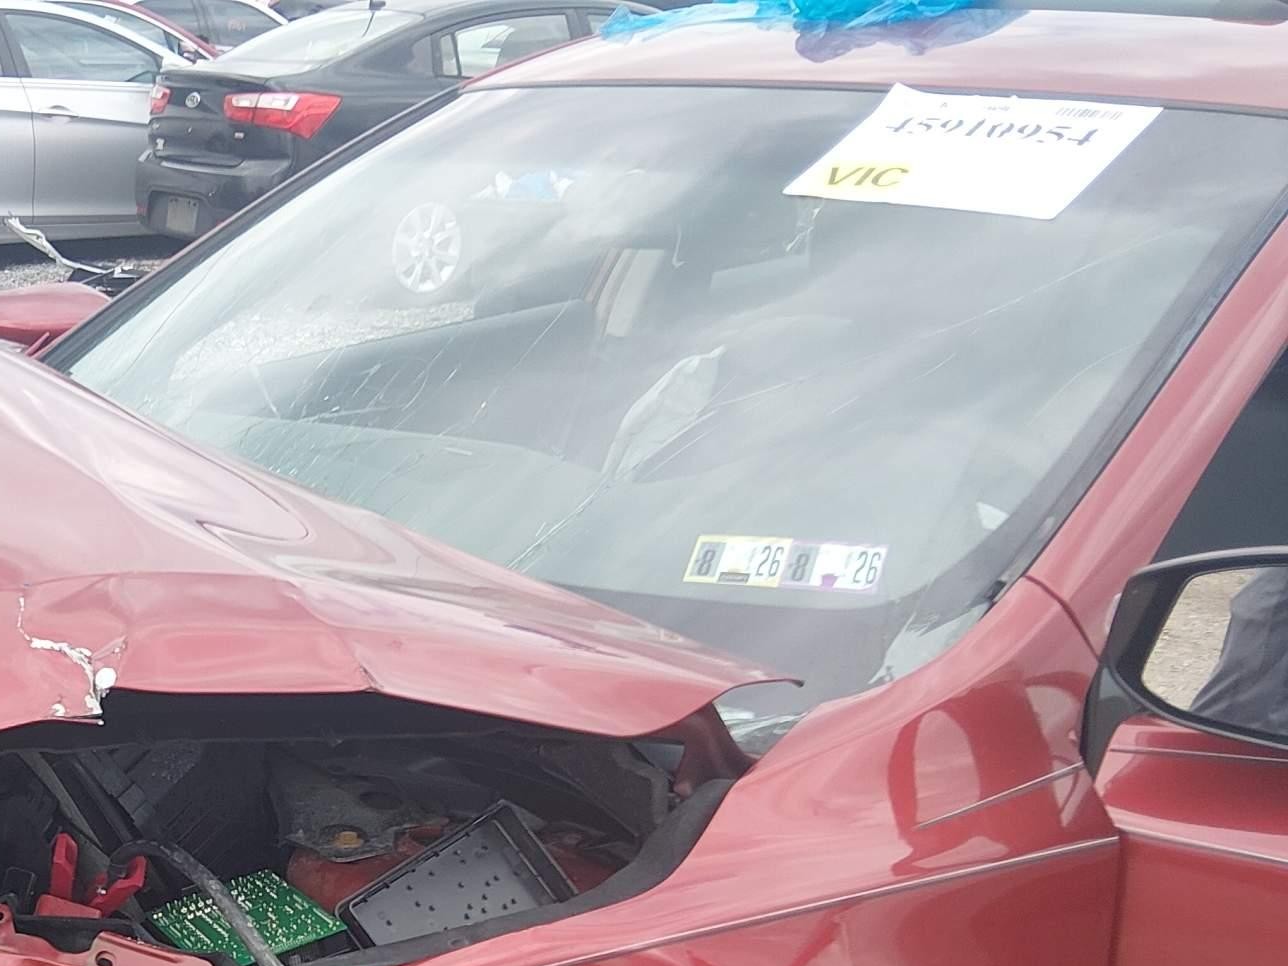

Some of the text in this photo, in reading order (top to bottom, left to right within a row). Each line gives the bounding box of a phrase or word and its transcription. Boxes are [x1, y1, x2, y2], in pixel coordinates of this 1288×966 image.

[886, 117, 1099, 147] 45910954
[827, 166, 910, 188] VIC
[697, 545, 785, 578] 8 26
[791, 551, 881, 585] 8 26
